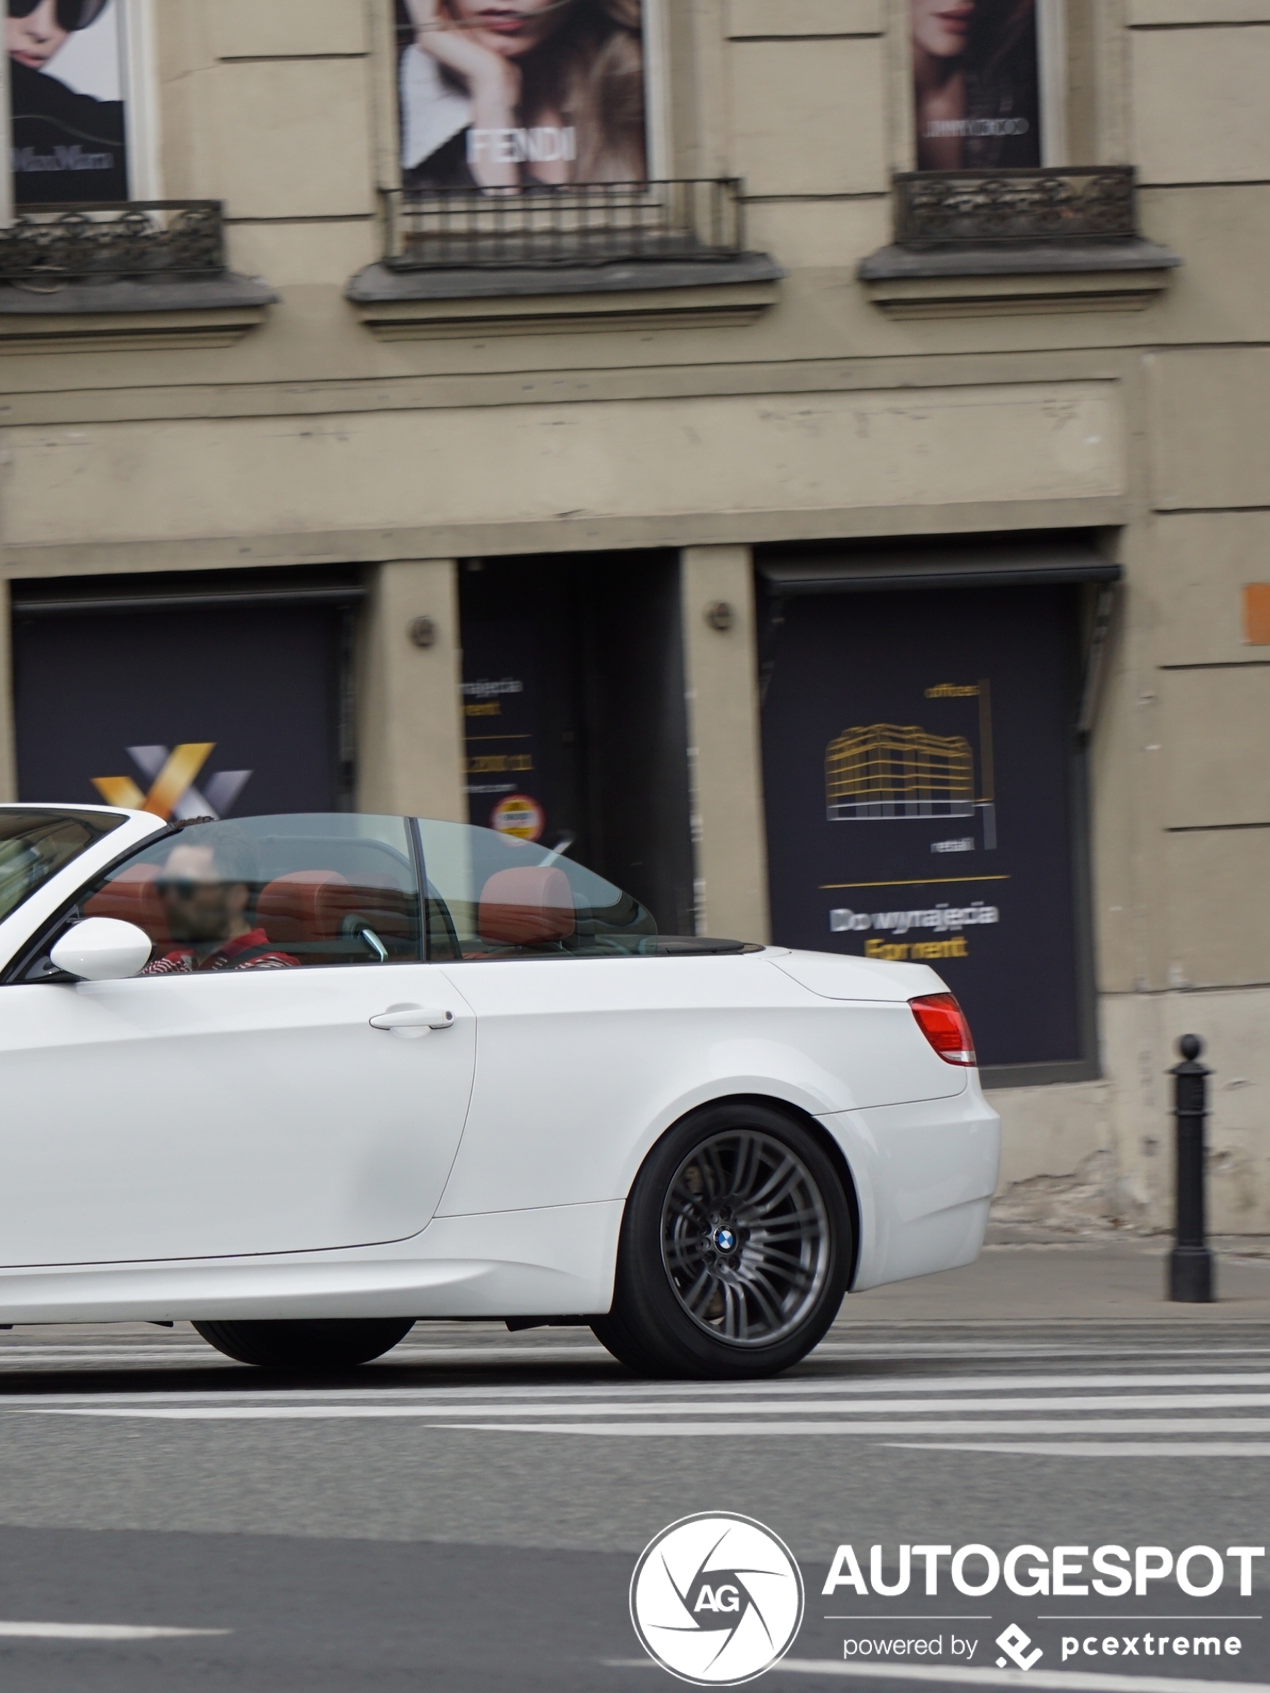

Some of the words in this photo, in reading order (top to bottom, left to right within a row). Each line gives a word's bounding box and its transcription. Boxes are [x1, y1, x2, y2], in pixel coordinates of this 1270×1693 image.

[466, 127, 576, 163] FENDI
[924, 683, 980, 699] offices
[930, 836, 975, 853] retail
[830, 908, 872, 932] Do
[871, 901, 999, 935] wynajęcia
[864, 938, 908, 961] For
[911, 936, 968, 960] rent
